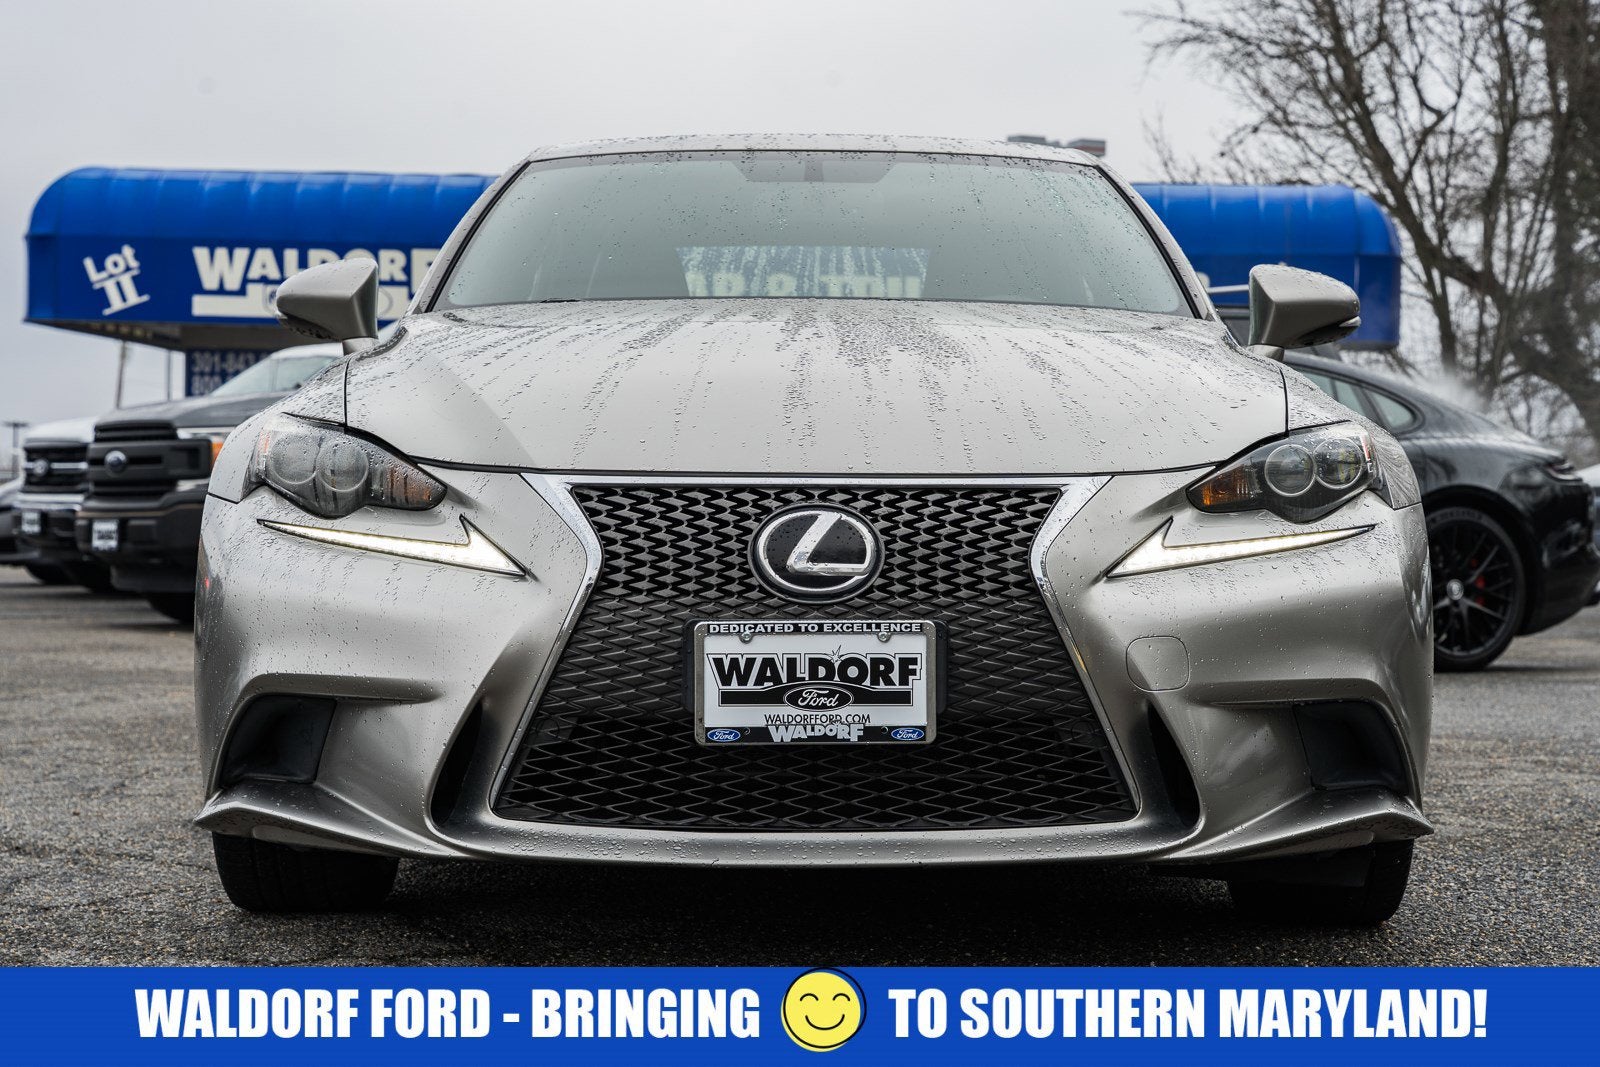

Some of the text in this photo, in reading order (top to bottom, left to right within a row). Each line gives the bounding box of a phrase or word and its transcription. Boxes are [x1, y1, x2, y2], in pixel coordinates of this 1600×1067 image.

[83, 244, 141, 284] Lot
[709, 623, 921, 634] DEDICATED TO EXCELLENCE
[711, 655, 919, 687] WALDORF
[797, 688, 839, 708] Ford
[764, 713, 871, 724] WALDORFFORD.COM
[712, 730, 736, 741] Ford
[767, 723, 864, 742] WALDORF
[897, 729, 919, 740] Ford
